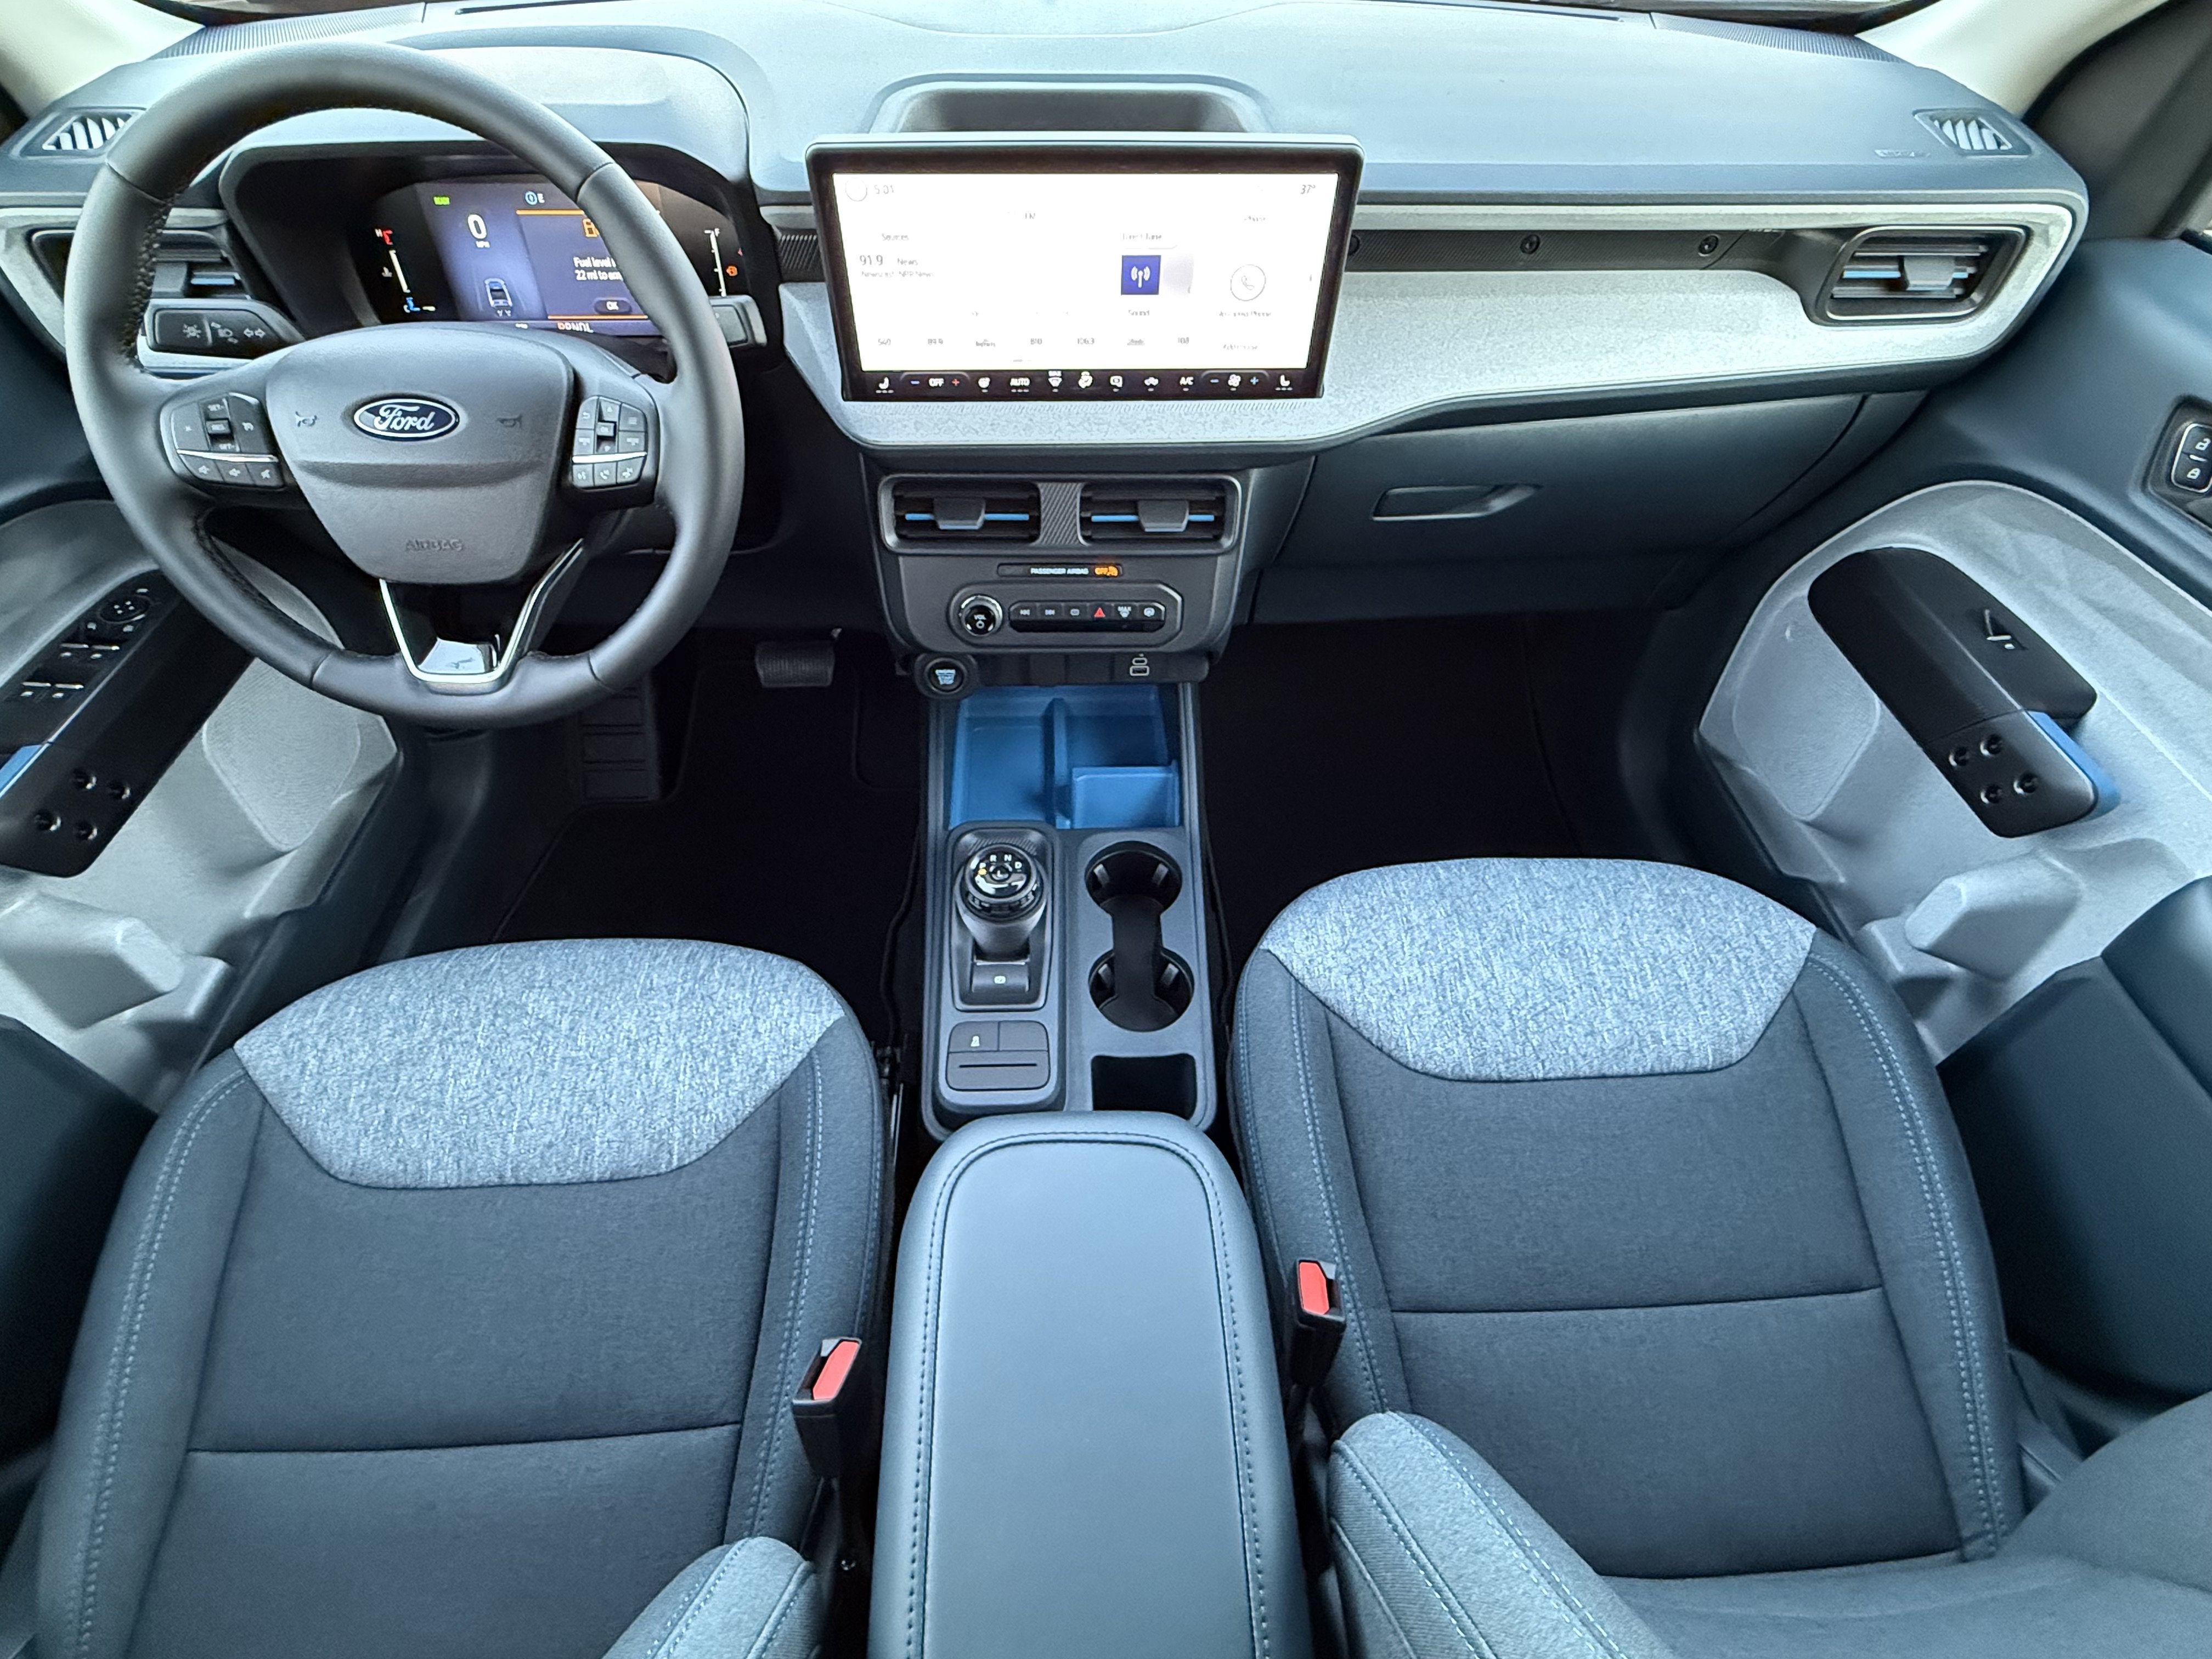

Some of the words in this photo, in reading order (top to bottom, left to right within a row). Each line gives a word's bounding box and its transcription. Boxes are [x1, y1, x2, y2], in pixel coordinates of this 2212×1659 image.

[467, 214, 487, 239] 0
[573, 257, 592, 268] Fuel
[574, 269, 587, 280] 22
[608, 272, 623, 281] em
[606, 301, 619, 311] OK
[374, 404, 436, 431] Ford
